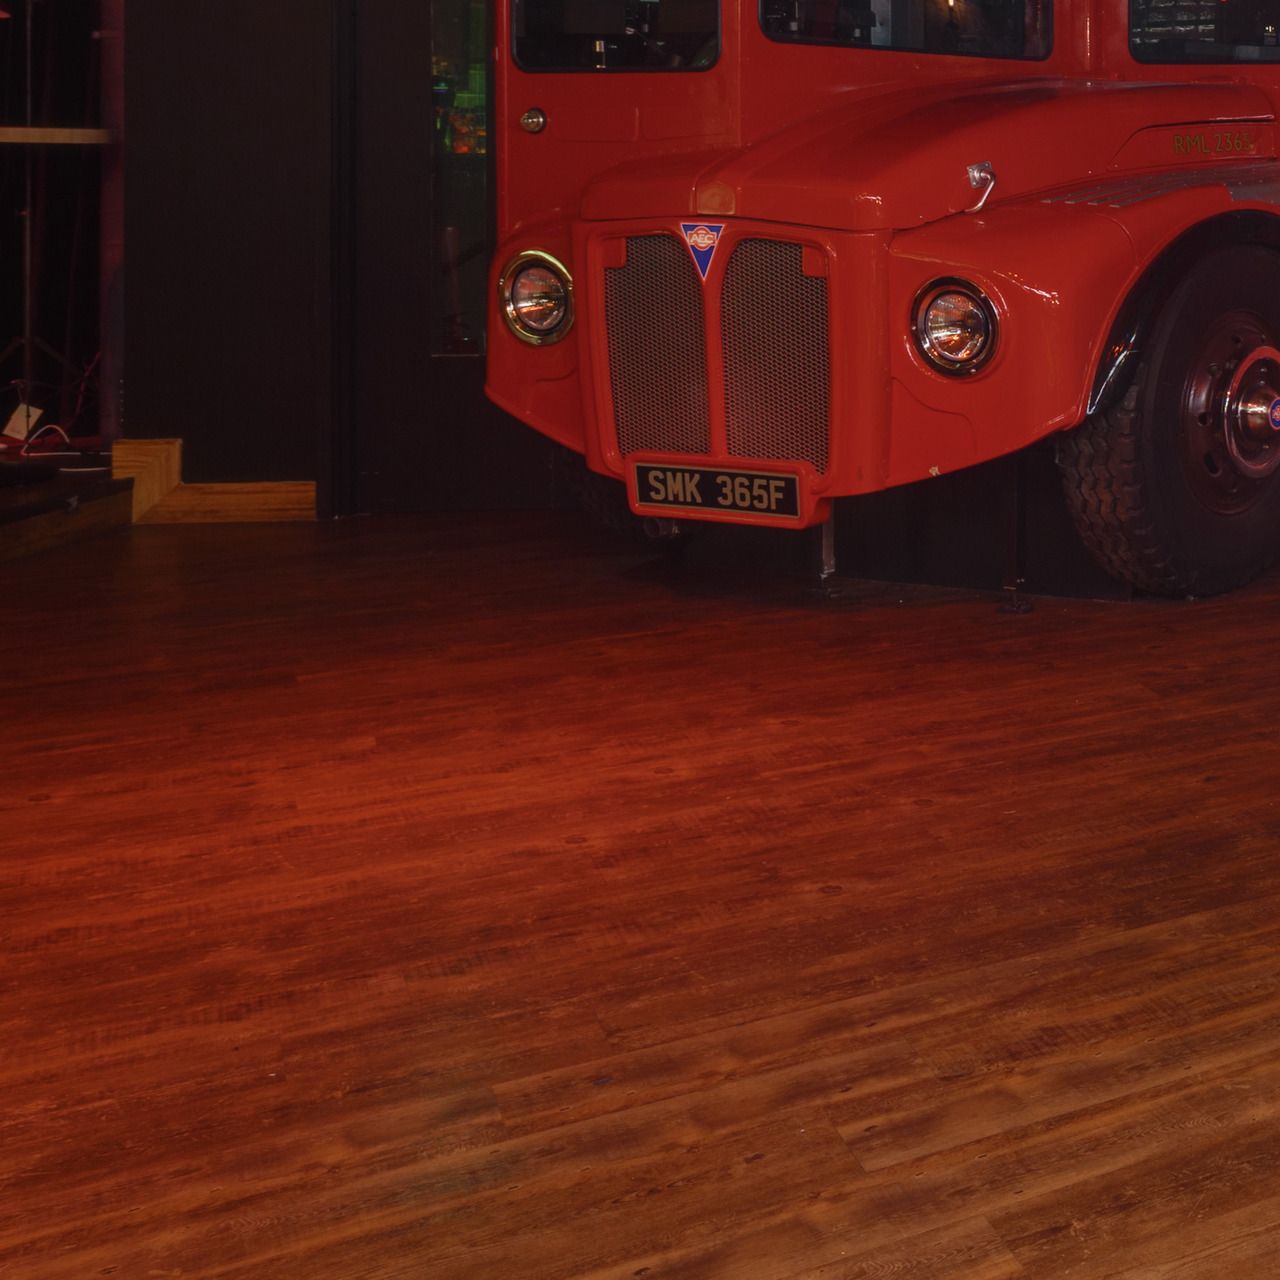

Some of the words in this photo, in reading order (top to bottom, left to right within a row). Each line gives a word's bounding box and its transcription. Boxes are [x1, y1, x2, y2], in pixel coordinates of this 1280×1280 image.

[1173, 135, 1211, 154] RML
[690, 233, 714, 245] AEC
[648, 470, 702, 504] SMK
[715, 474, 786, 511] 365F
